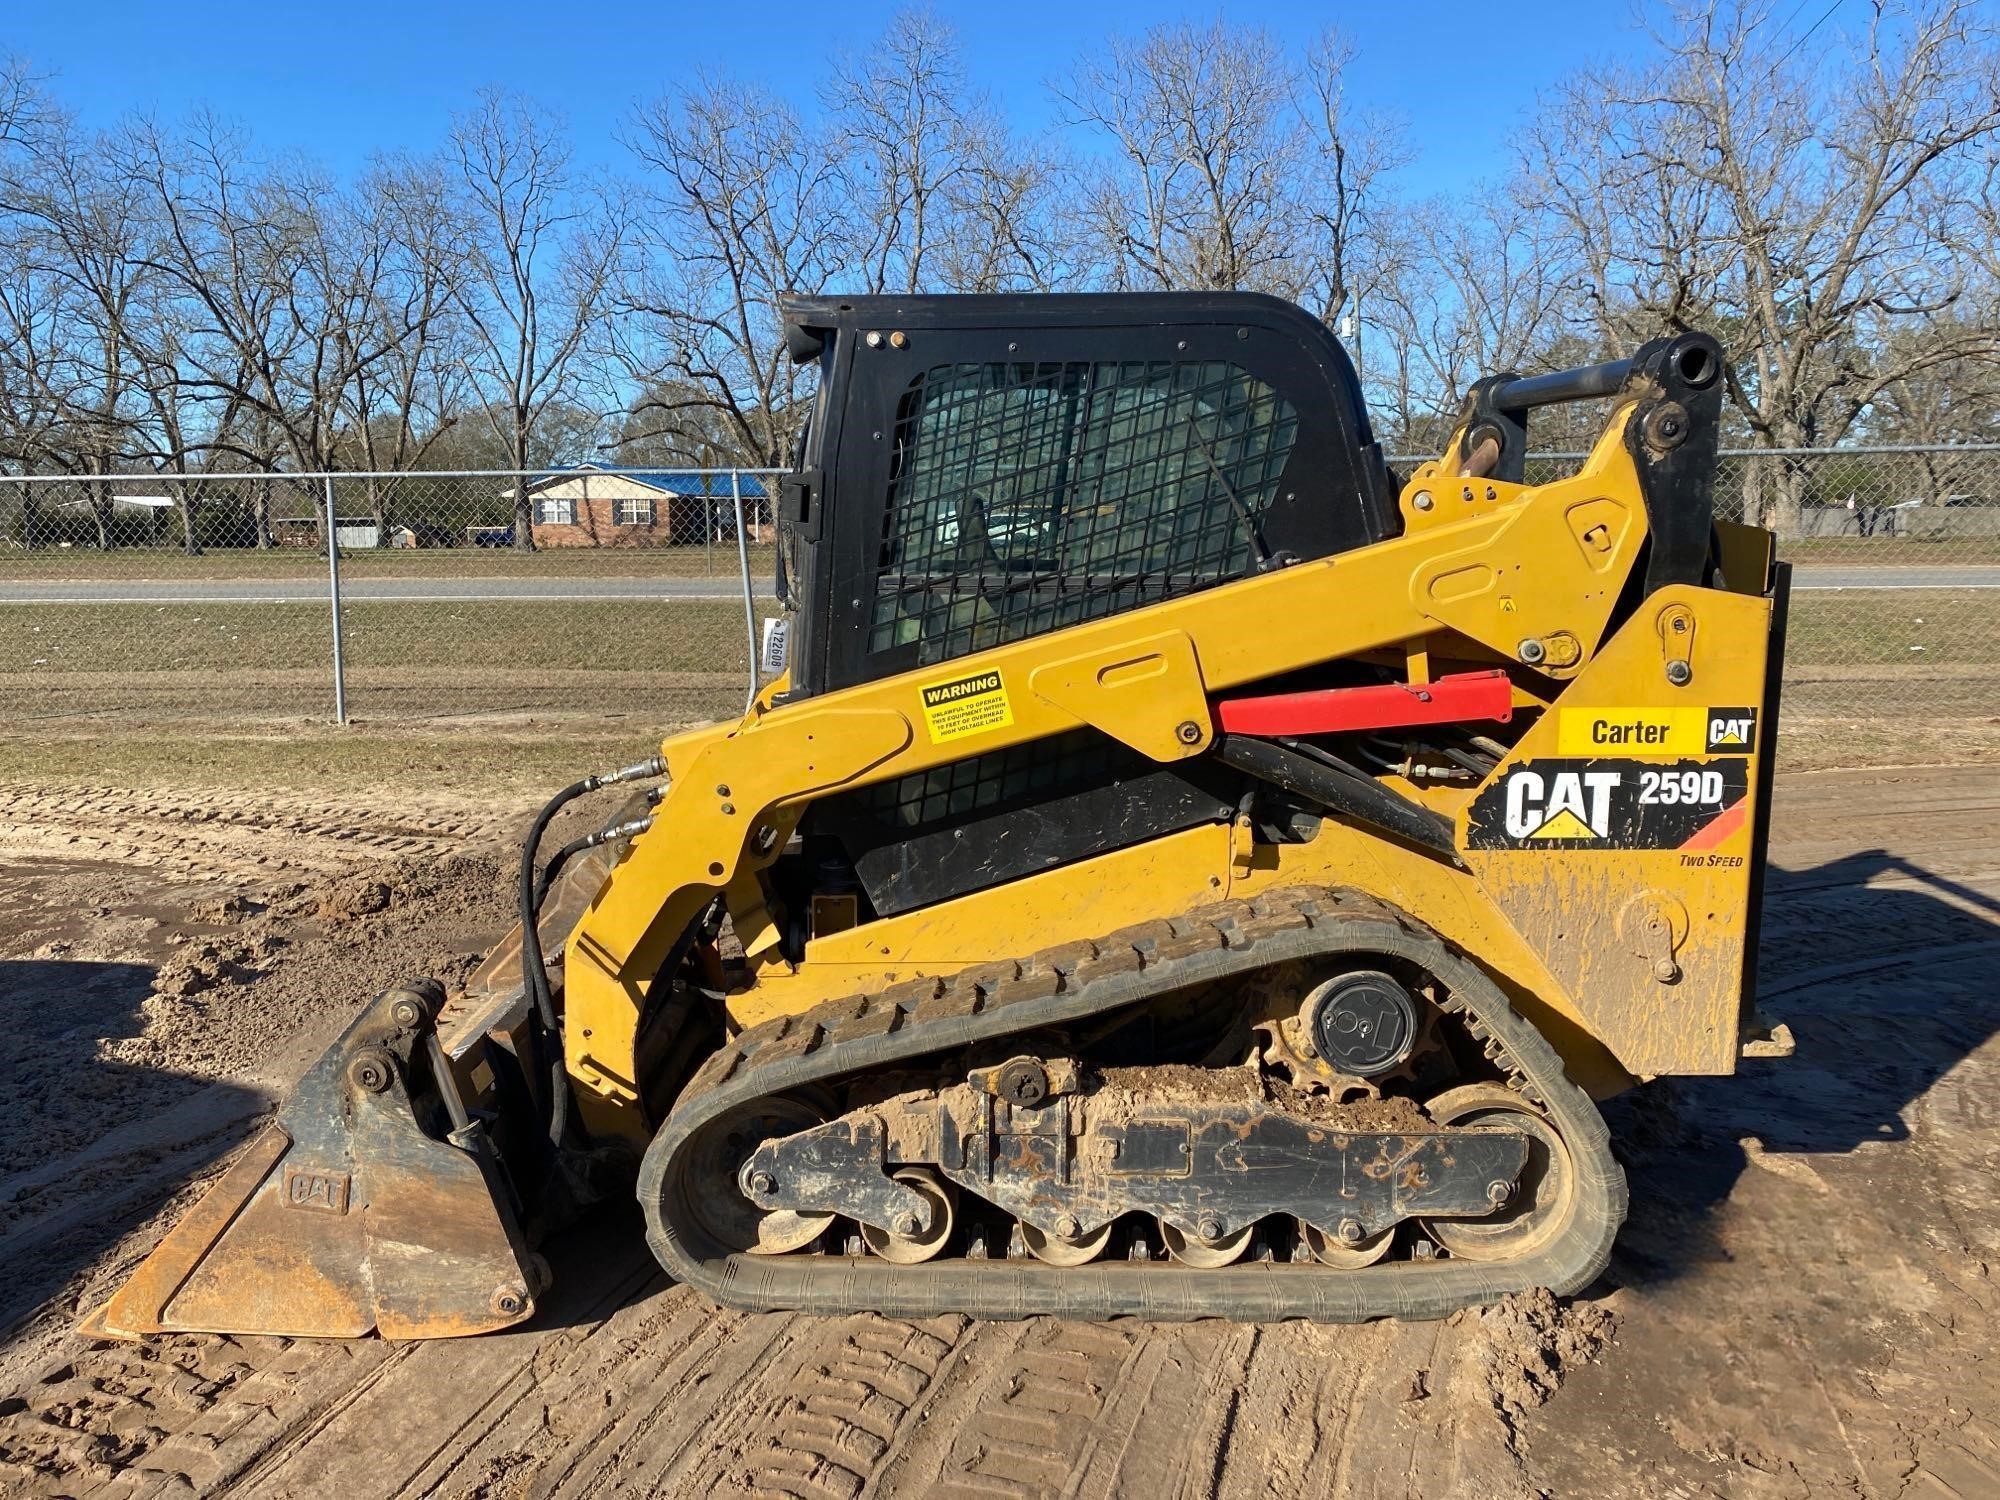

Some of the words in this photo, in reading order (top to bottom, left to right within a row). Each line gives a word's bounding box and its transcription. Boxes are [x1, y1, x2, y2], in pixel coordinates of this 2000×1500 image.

[771, 631, 785, 667] 122608
[927, 676, 998, 703] WARNING
[931, 706, 964, 719] UNLAWFUL
[975, 696, 1003, 708] OPERATE
[932, 717, 946, 725] THIS
[947, 707, 983, 721] EQUIPMENT
[983, 702, 1006, 714] WITHIN
[945, 719, 961, 728] FEET
[971, 709, 1004, 722] OVERHEAD
[940, 728, 957, 737] HIGH
[958, 720, 985, 732] VOLTAGE
[985, 715, 1004, 725] LINES
[1592, 719, 1670, 744] Carter
[1709, 719, 1753, 747] CAT
[1505, 771, 1621, 838] CAT
[1638, 771, 1724, 804] 259D
[290, 1174, 341, 1208] CAT
